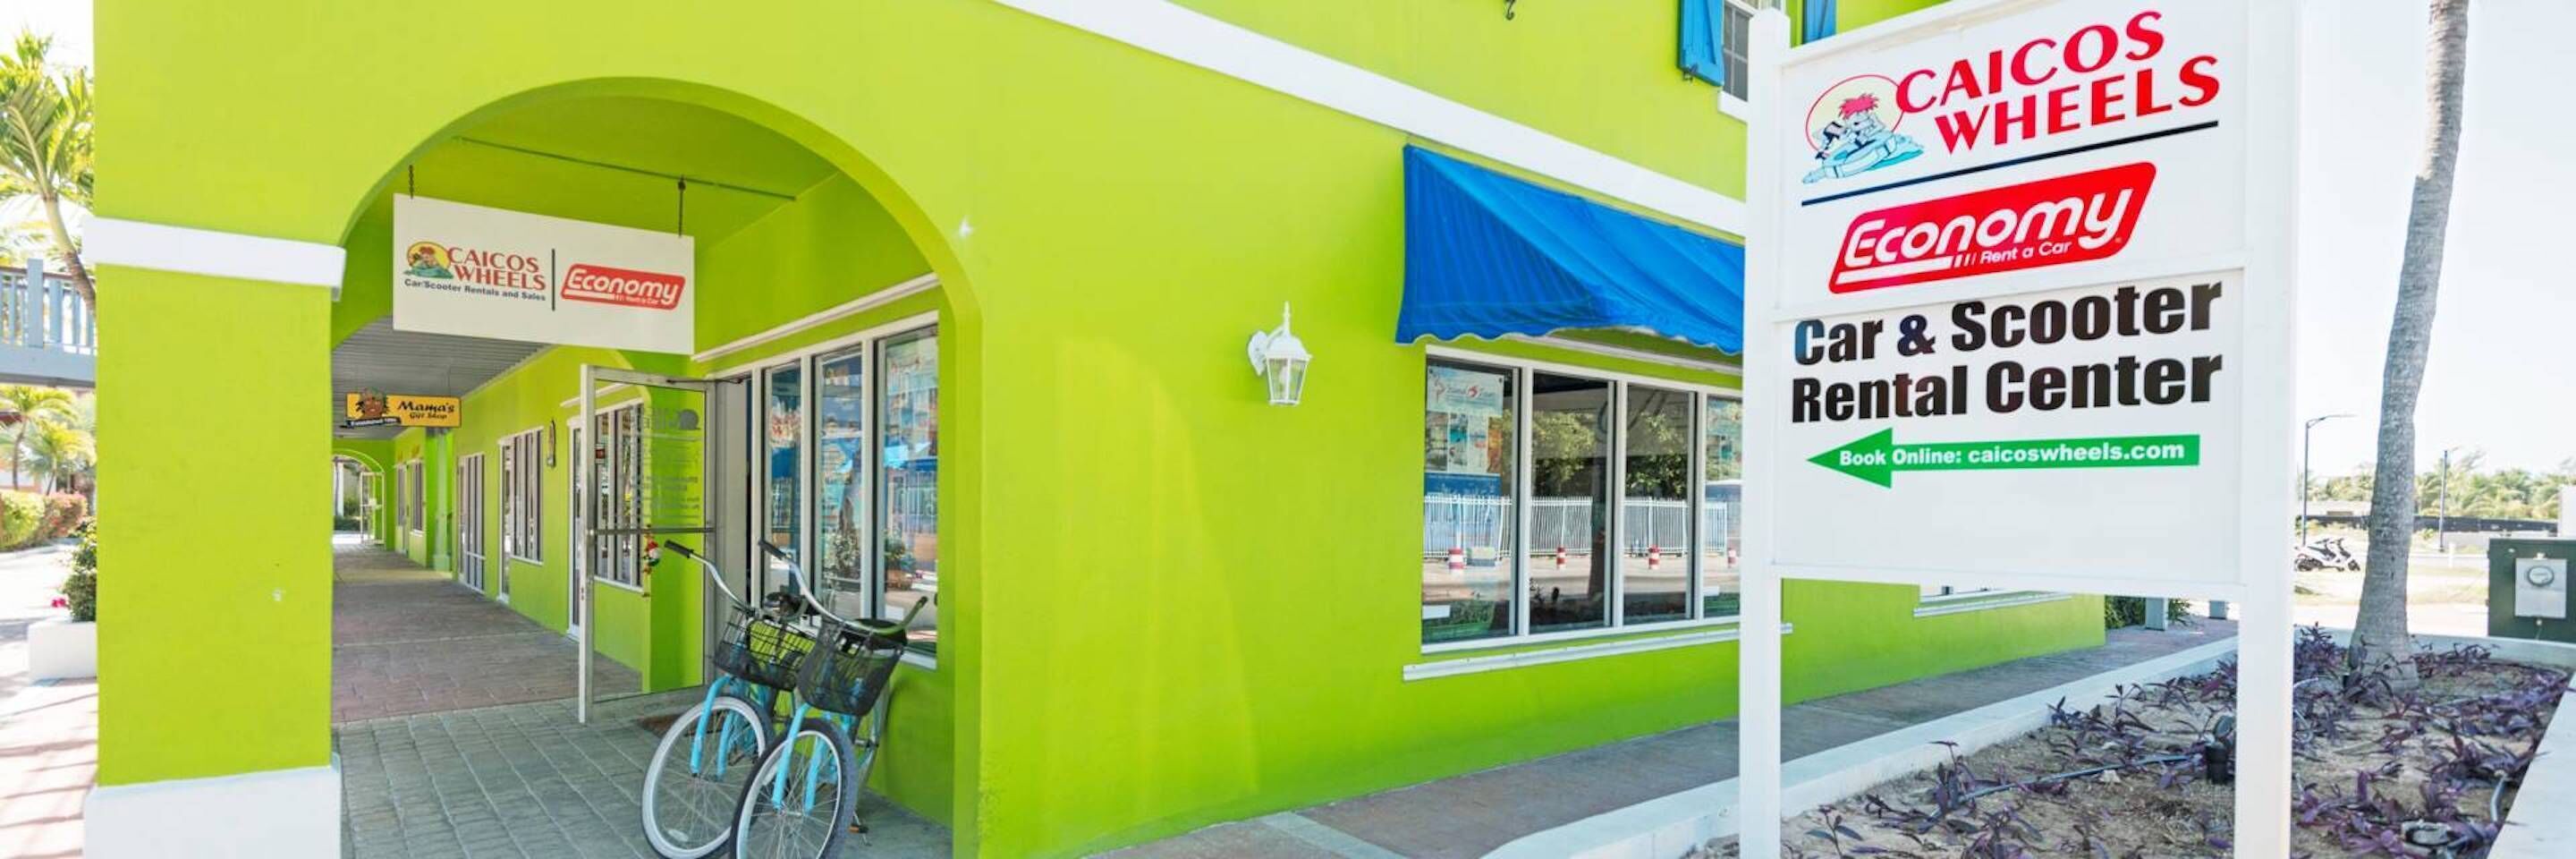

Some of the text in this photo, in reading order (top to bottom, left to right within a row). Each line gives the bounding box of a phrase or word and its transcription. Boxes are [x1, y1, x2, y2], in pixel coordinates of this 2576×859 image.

[1895, 10, 2165, 114] CAICOS
[1935, 55, 2220, 155] WHEELS
[1843, 187, 2134, 268] Economy
[447, 247, 539, 273] CAICOS
[1979, 241, 2072, 265] Rent a Car
[453, 264, 547, 291] WHEELS
[567, 268, 679, 304] Economy
[464, 285, 500, 296] Rentals
[502, 290, 520, 299] and
[521, 292, 547, 302] Sales
[1793, 281, 2222, 365] Car & Scooter
[1792, 354, 2223, 423] Rental Center
[397, 400, 455, 413] Mama's
[1839, 442, 2185, 466] Book Online: caicoswheels.com
